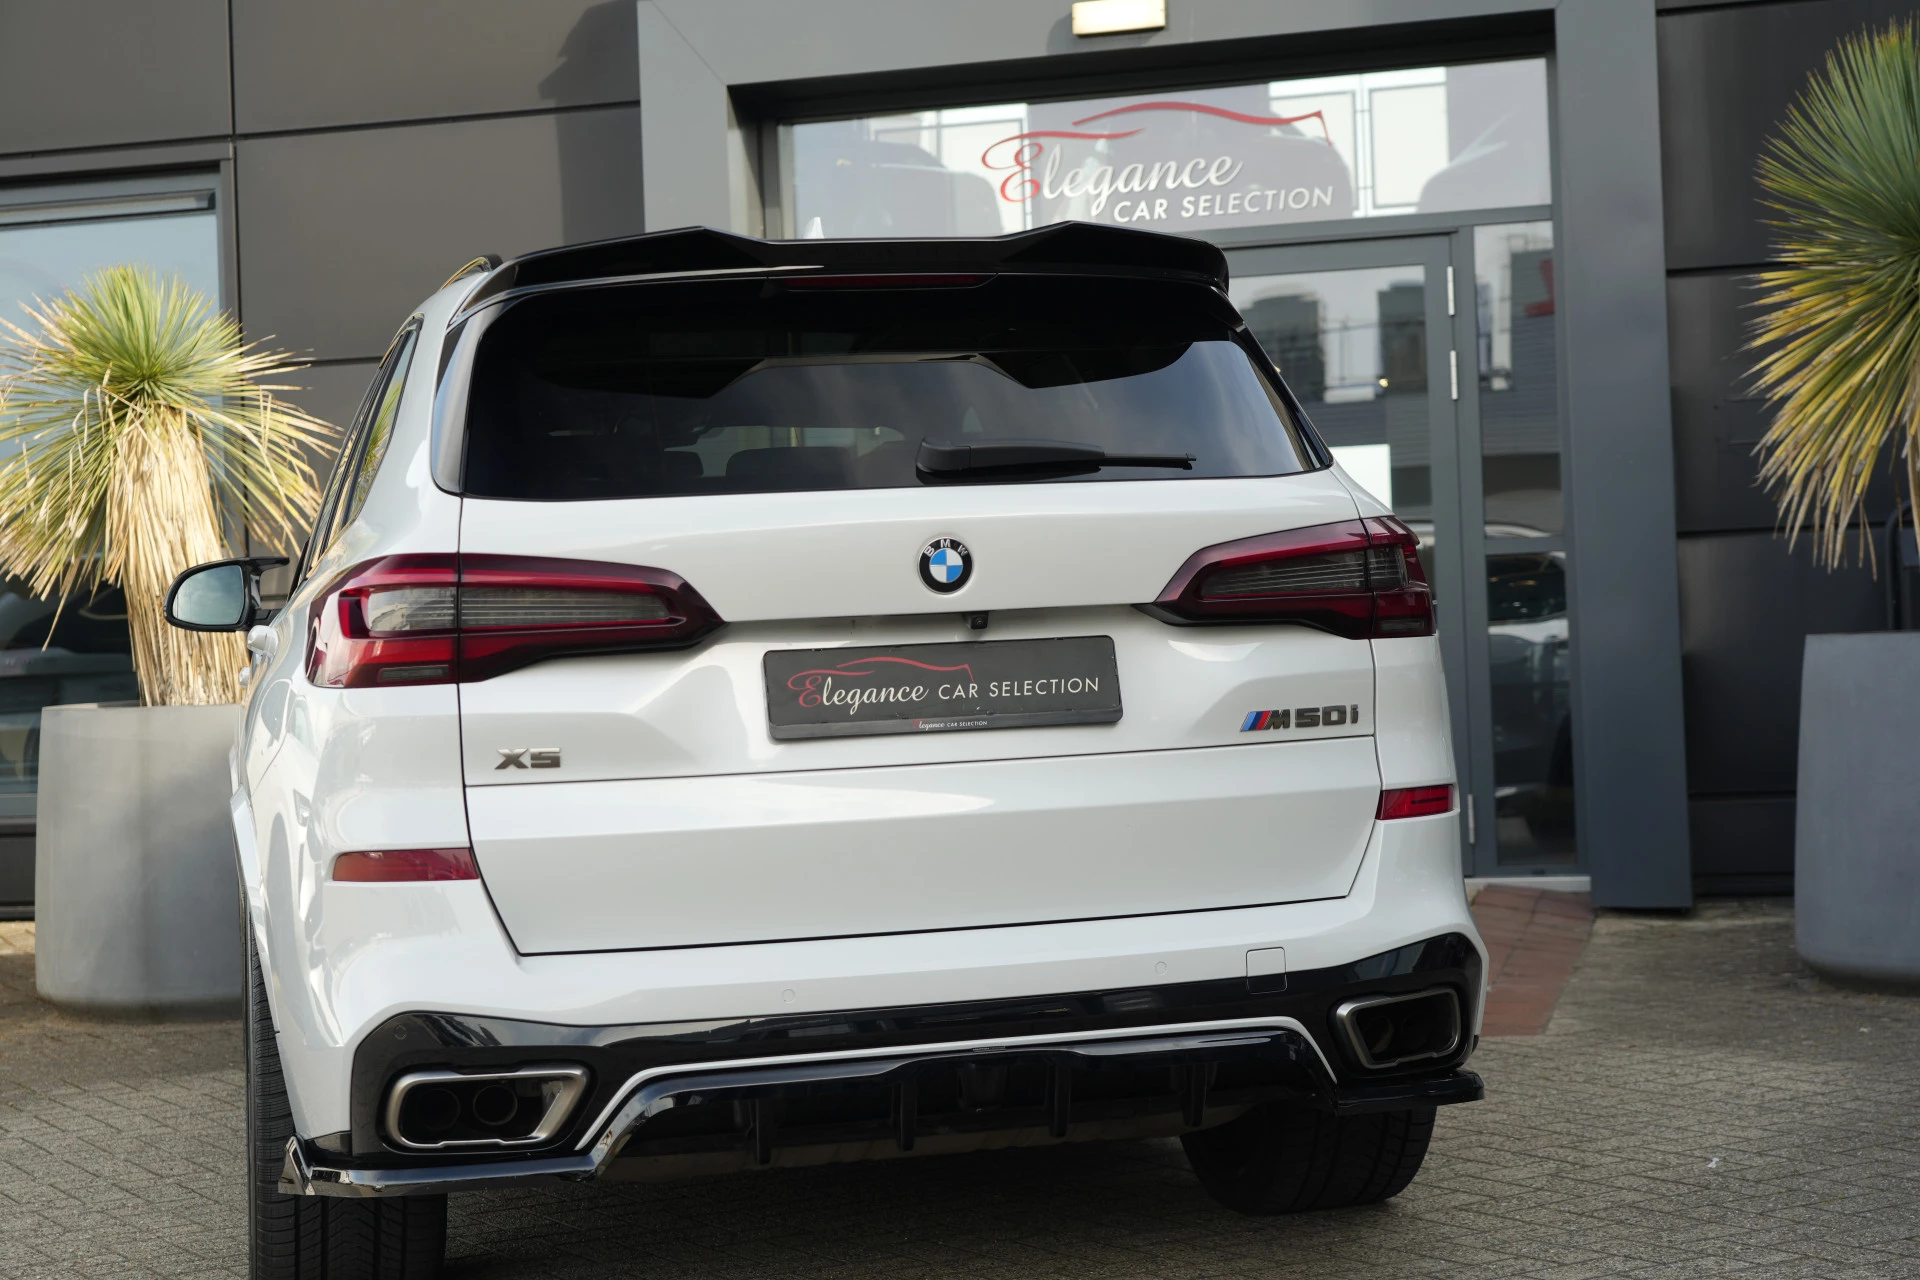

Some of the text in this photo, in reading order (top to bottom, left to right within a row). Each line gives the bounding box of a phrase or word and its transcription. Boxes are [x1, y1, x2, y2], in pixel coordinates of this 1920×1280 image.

[981, 131, 1243, 217] Elegance
[1113, 185, 1334, 223] CAR SELECTION
[923, 538, 968, 557] BMW
[787, 669, 1099, 715] Elegance CAR SELECTION
[494, 747, 561, 770] X5
